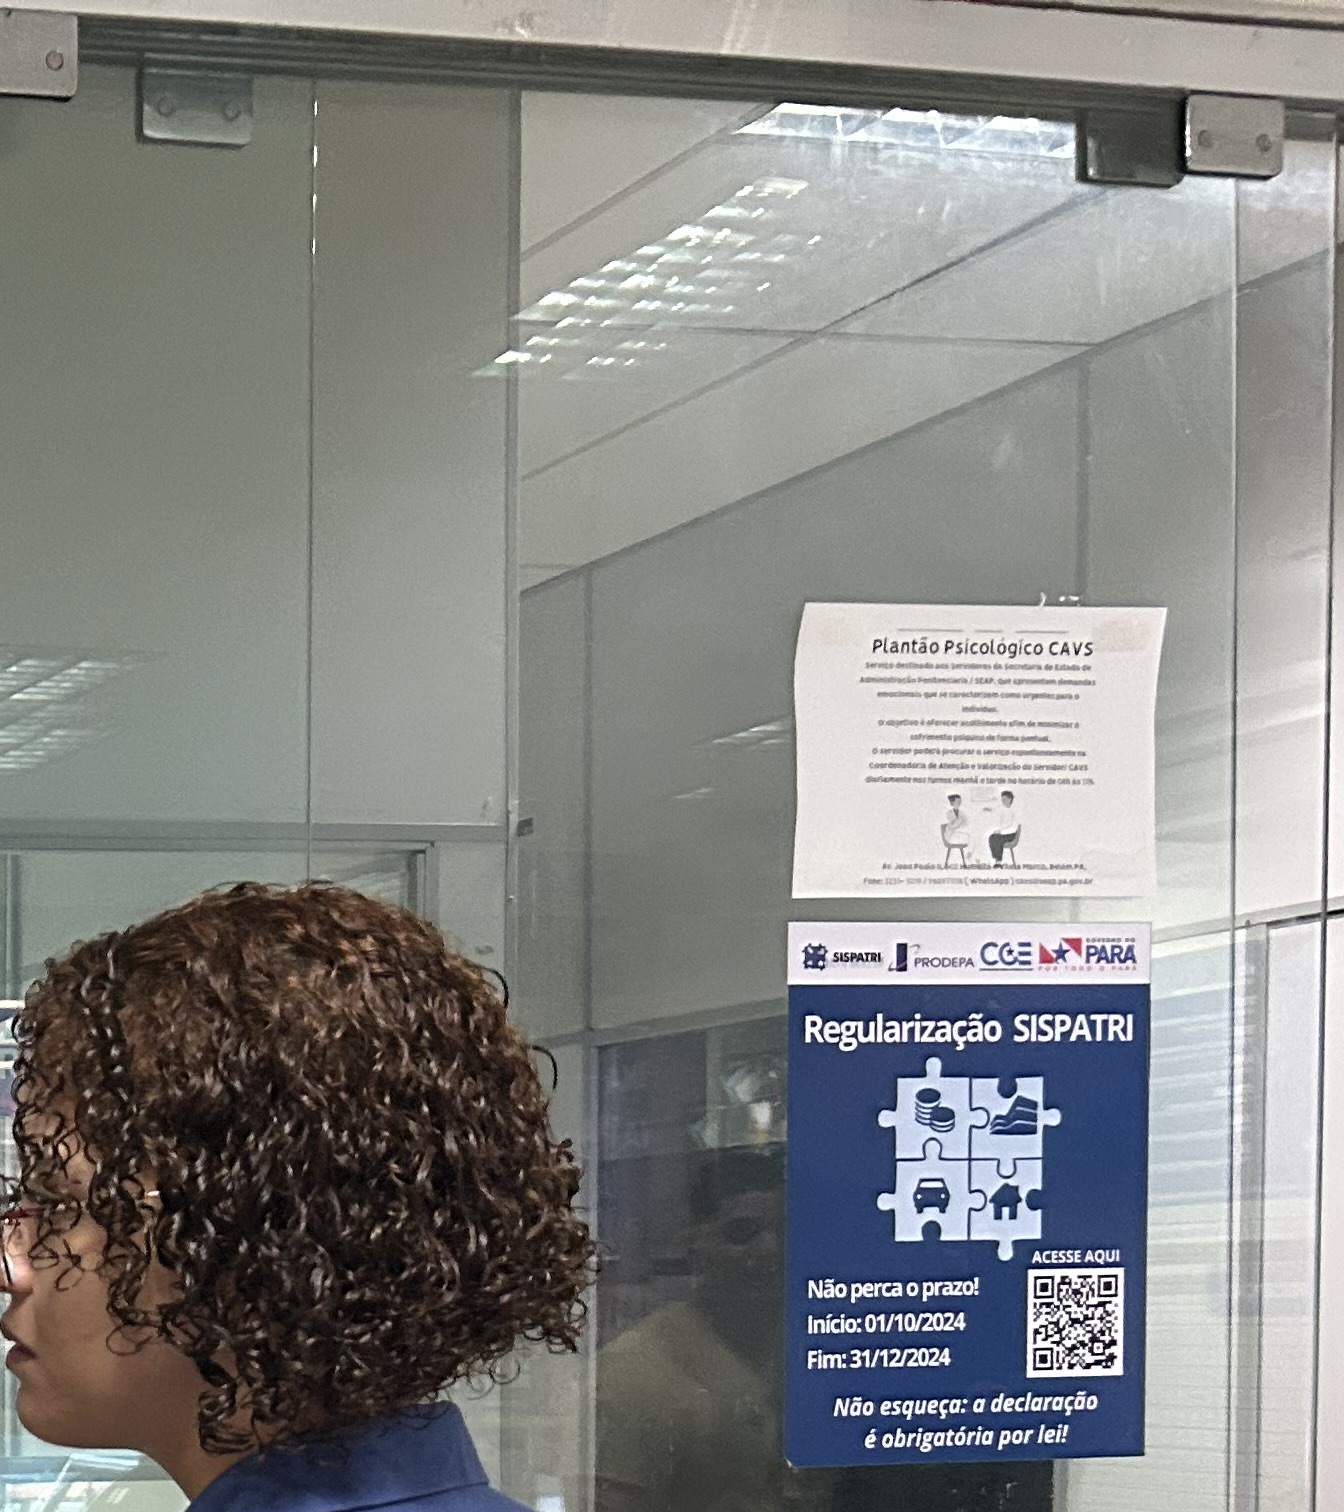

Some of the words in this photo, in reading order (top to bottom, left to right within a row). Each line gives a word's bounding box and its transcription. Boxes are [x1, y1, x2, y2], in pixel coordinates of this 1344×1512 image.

[872, 637, 939, 655] Plantão
[945, 638, 1044, 658] Psicológico
[1048, 641, 1094, 656] CAVS
[832, 952, 881, 963] SISPATRI
[914, 957, 974, 968] PRODEPA
[980, 941, 1032, 966] CGE
[804, 1013, 1002, 1051] Regularização
[1013, 1013, 1134, 1042] SISPATRI
[1032, 1250, 1081, 1264] ACESSE
[1084, 1249, 1120, 1264] AQUI
[808, 1278, 847, 1299] Não
[850, 1282, 902, 1303] perca
[906, 1282, 918, 1296] o
[922, 1277, 979, 1302] prazo!
[807, 1313, 862, 1334] Início:
[864, 1312, 966, 1333] 01/10/2024
[807, 1349, 847, 1369] Fim:
[850, 1348, 951, 1368] 31/12/2024
[833, 1396, 874, 1417] Não
[879, 1398, 968, 1420] esqueça:
[972, 1398, 986, 1413] a
[991, 1391, 1098, 1416] declaração
[864, 1428, 877, 1448] é
[881, 1425, 994, 1452] obrigatória
[998, 1426, 1033, 1450] por
[1037, 1424, 1069, 1444] lei!
